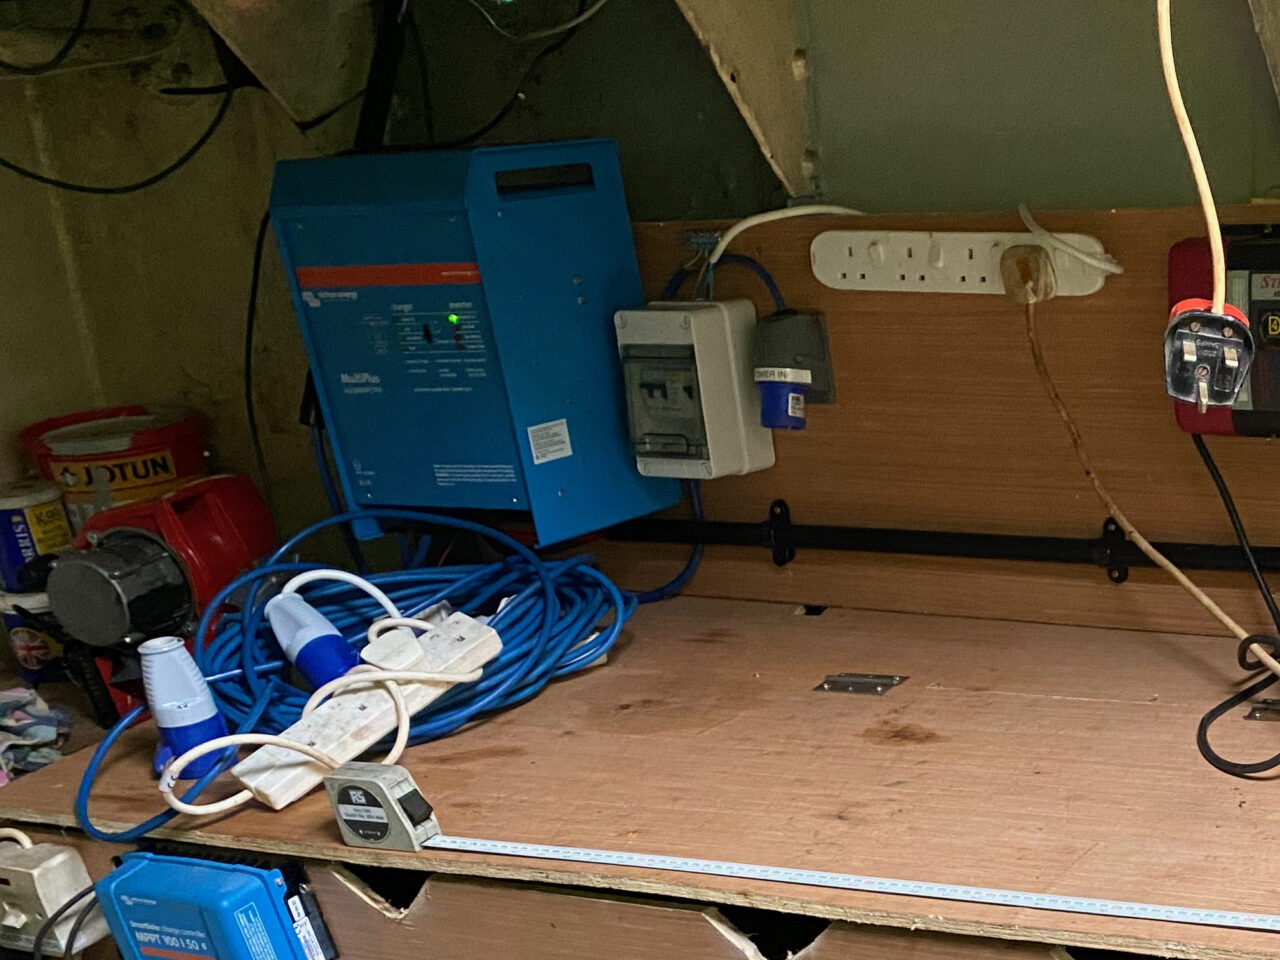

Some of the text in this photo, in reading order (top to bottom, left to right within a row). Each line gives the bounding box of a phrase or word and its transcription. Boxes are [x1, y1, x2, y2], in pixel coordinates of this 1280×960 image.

[348, 789, 367, 805] RS
[135, 931, 161, 944] MPPT
[163, 935, 179, 947] 100
[185, 939, 199, 950] 50
